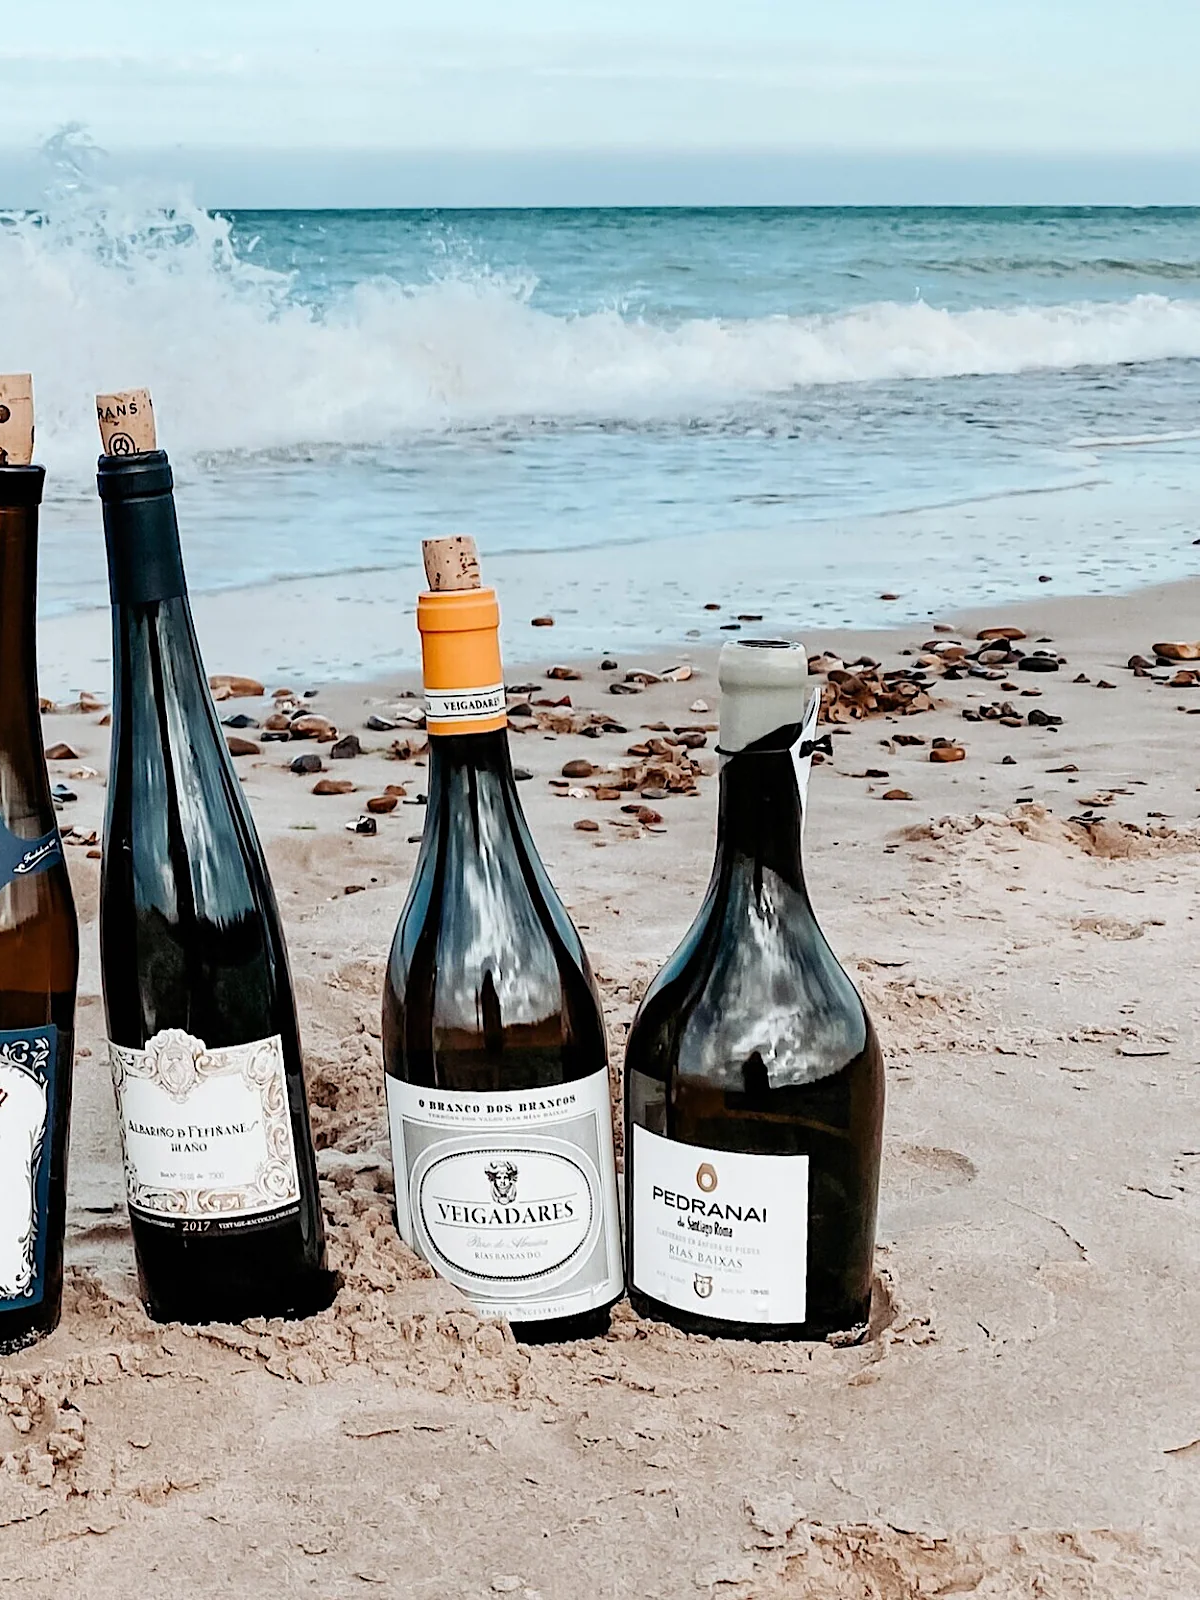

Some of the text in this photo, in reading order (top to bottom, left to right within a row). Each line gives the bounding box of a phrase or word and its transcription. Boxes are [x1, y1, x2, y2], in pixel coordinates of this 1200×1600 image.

[443, 696, 500, 711] VEIGADARES
[429, 1101, 480, 1114] BRANCO
[486, 1104, 513, 1114] DOS
[519, 1094, 577, 1112] BRANCOS
[128, 1119, 175, 1139] ALBARIÑO
[438, 1200, 575, 1225] VEIGADARES
[652, 1185, 768, 1223] PEDRANAI
[182, 1221, 211, 1232] 2017
[677, 1215, 734, 1238] de Santiago Roma
[495, 1251, 526, 1261] BAIXAS
[668, 1243, 743, 1268] RÍAS BAIXAS
